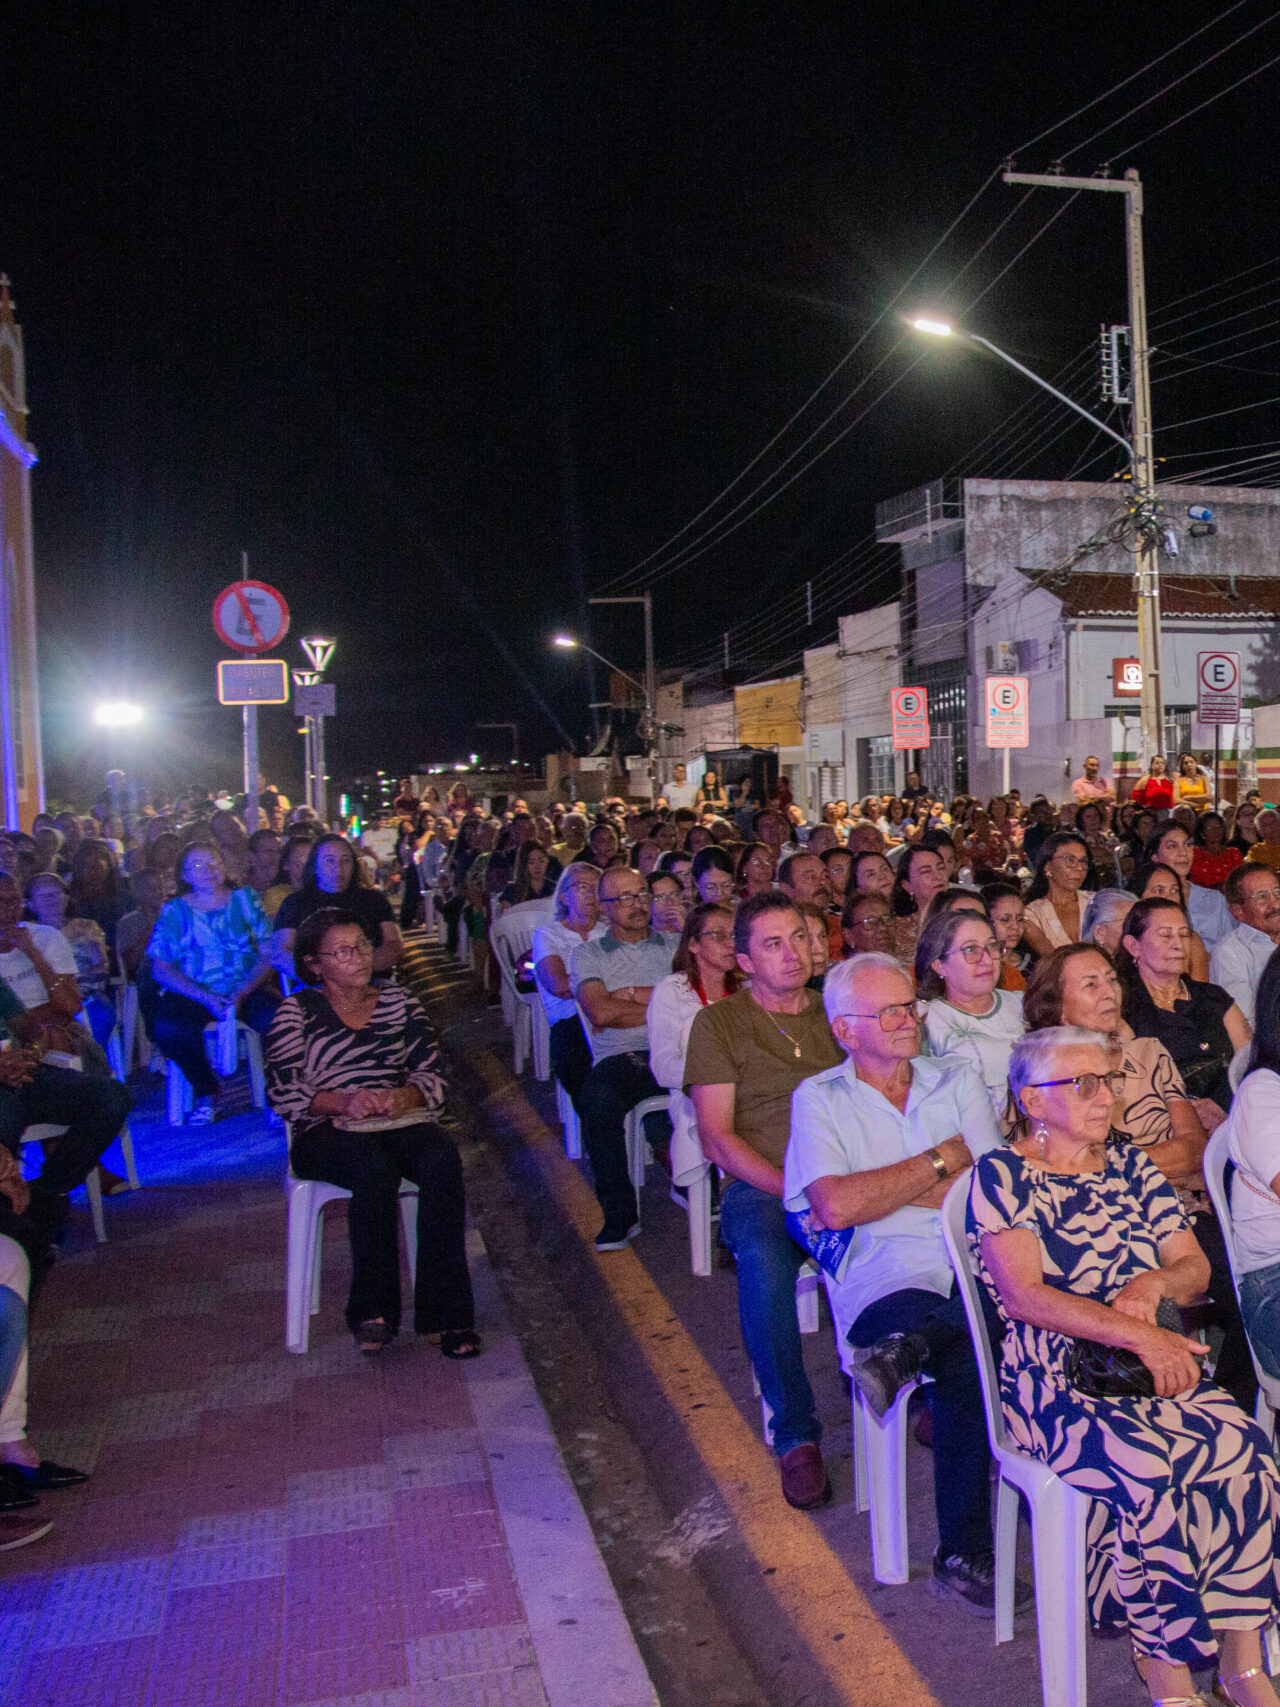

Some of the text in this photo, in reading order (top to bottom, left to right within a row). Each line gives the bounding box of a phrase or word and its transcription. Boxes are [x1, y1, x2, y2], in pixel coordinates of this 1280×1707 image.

[1213, 664, 1225, 682] E
[904, 696, 913, 710] E
[1002, 689, 1012, 704] E
